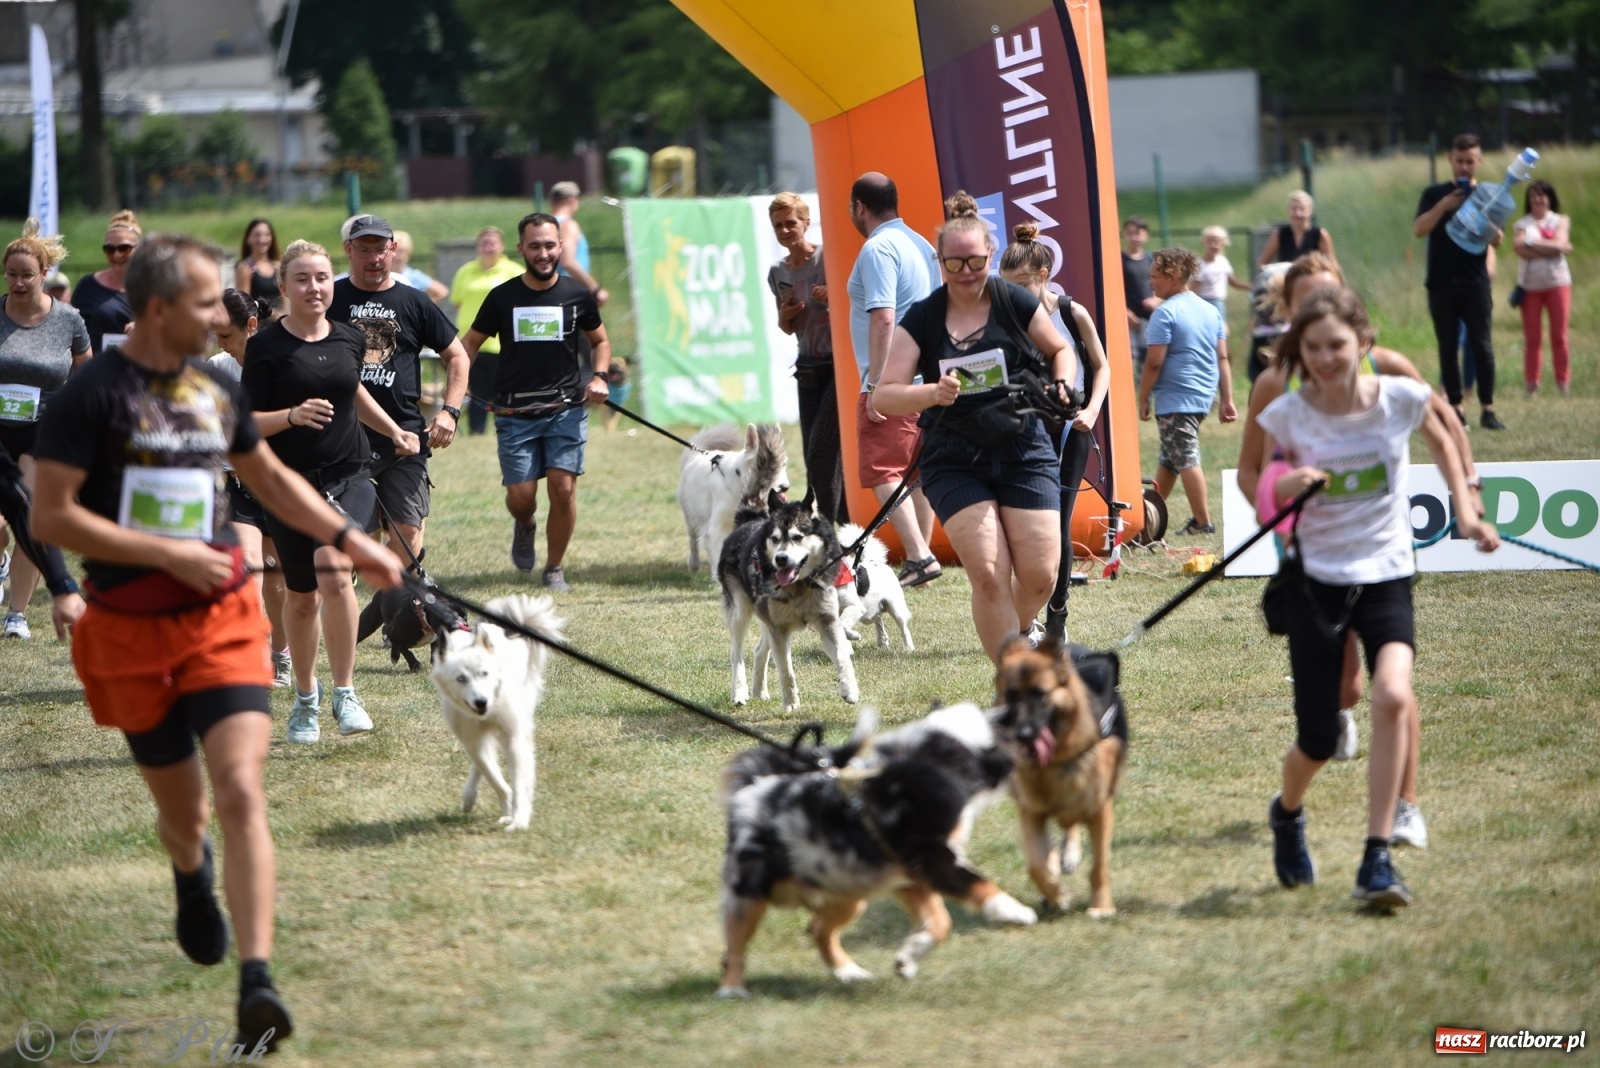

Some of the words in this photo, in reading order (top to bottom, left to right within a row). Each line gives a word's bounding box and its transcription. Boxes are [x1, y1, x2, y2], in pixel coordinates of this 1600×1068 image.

[681, 241, 745, 292] ZOO
[349, 304, 397, 319] Merrier
[532, 323, 546, 334] 14
[360, 368, 396, 388] taffy
[3, 401, 20, 413] 32
[1344, 474, 1359, 492] 6
